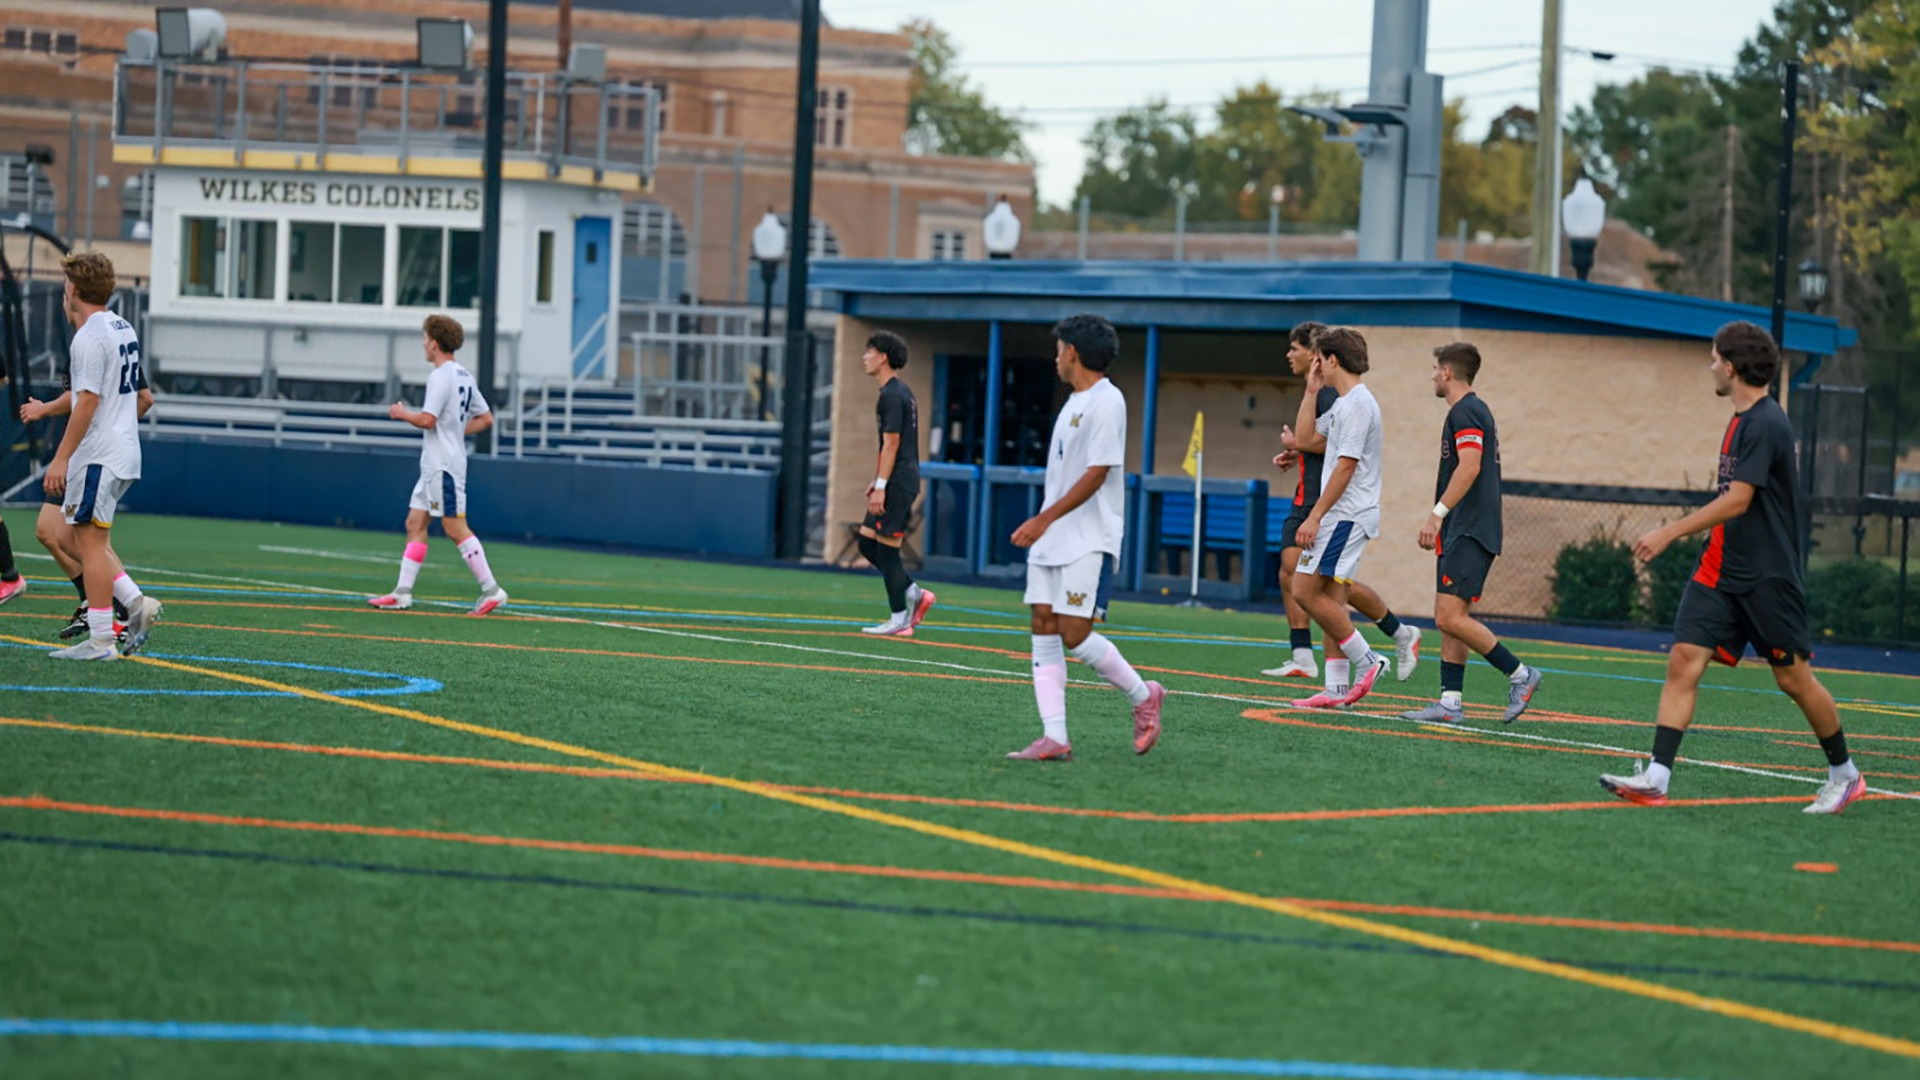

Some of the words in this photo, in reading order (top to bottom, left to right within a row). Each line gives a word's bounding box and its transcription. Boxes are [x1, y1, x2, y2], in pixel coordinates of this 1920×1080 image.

[199, 177, 317, 206] WILKES
[326, 182, 480, 211] COLONELS
[119, 341, 139, 395] 22
